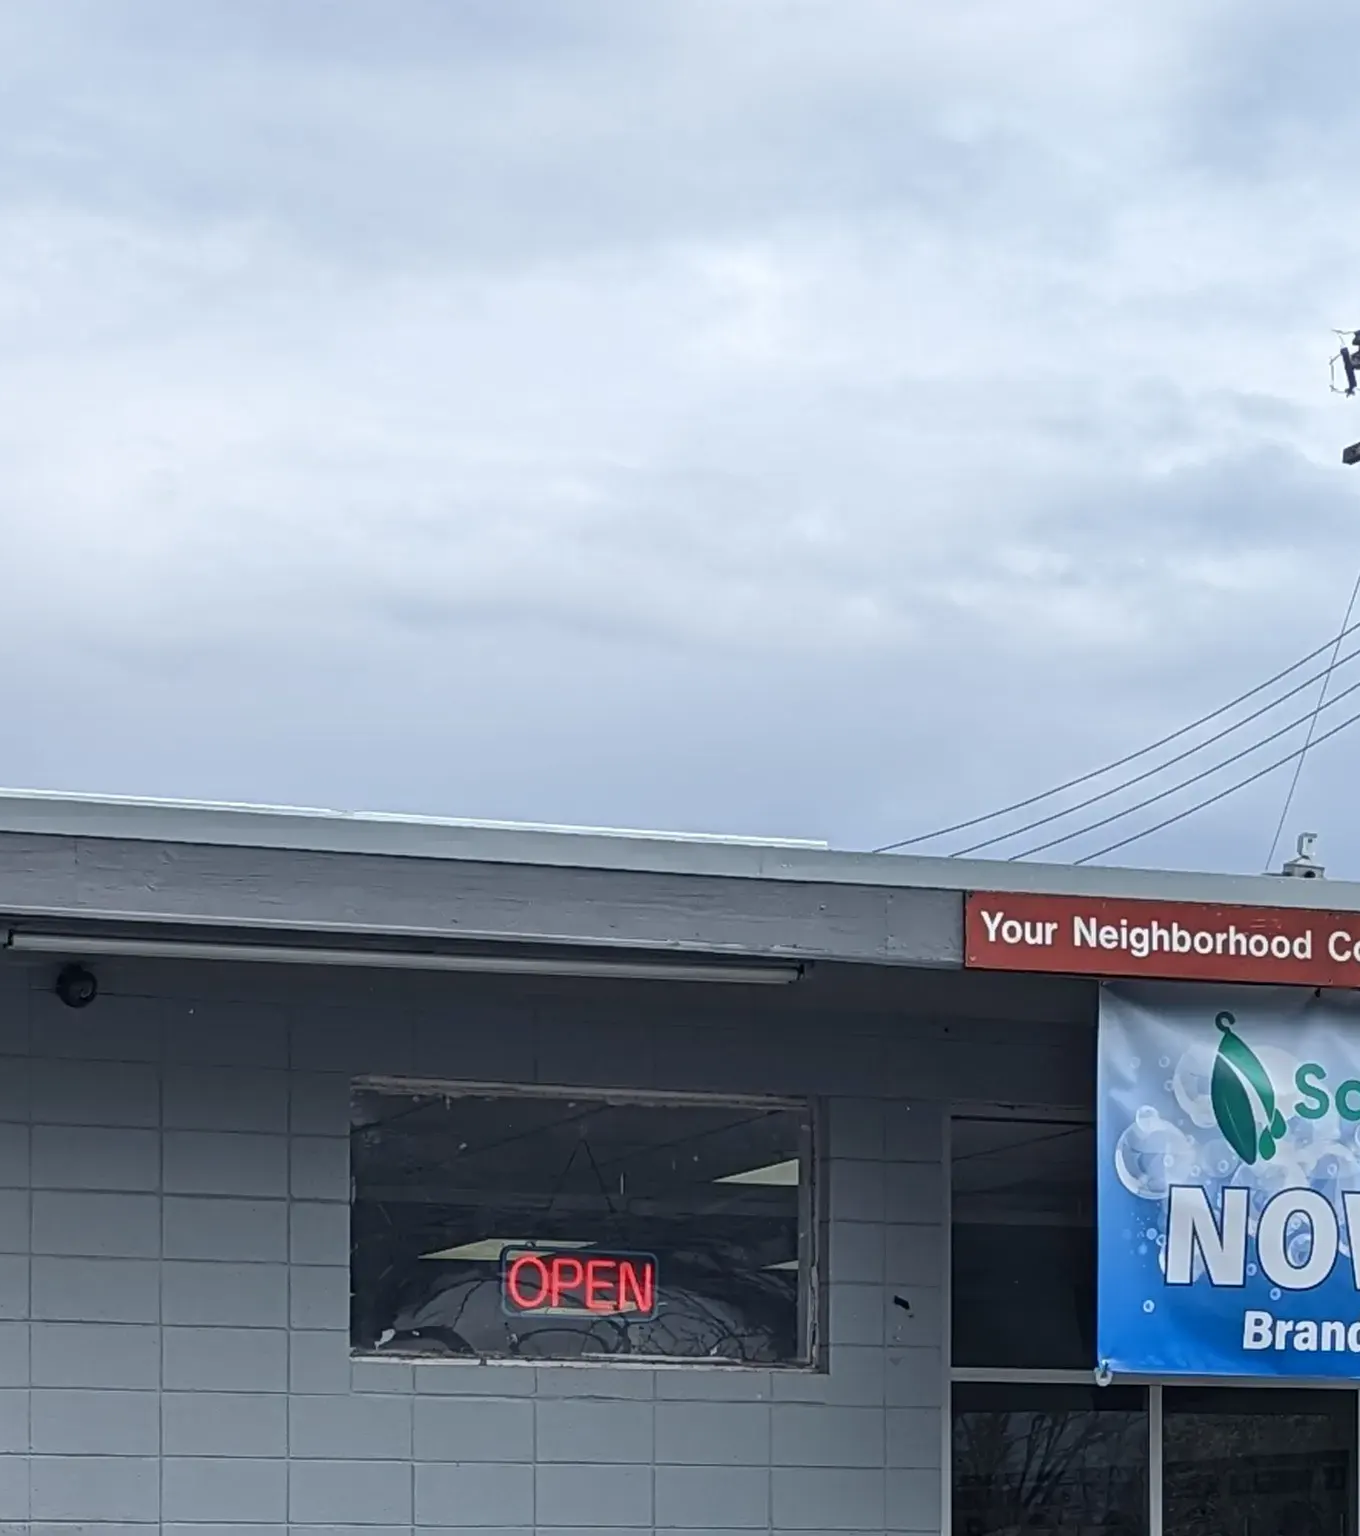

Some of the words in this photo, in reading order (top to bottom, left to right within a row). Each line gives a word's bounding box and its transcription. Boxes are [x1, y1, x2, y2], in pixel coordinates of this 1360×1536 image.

[981, 910, 1058, 945] Your
[1073, 915, 1313, 960] Neighborhood
[507, 1255, 653, 1312] OPEN
